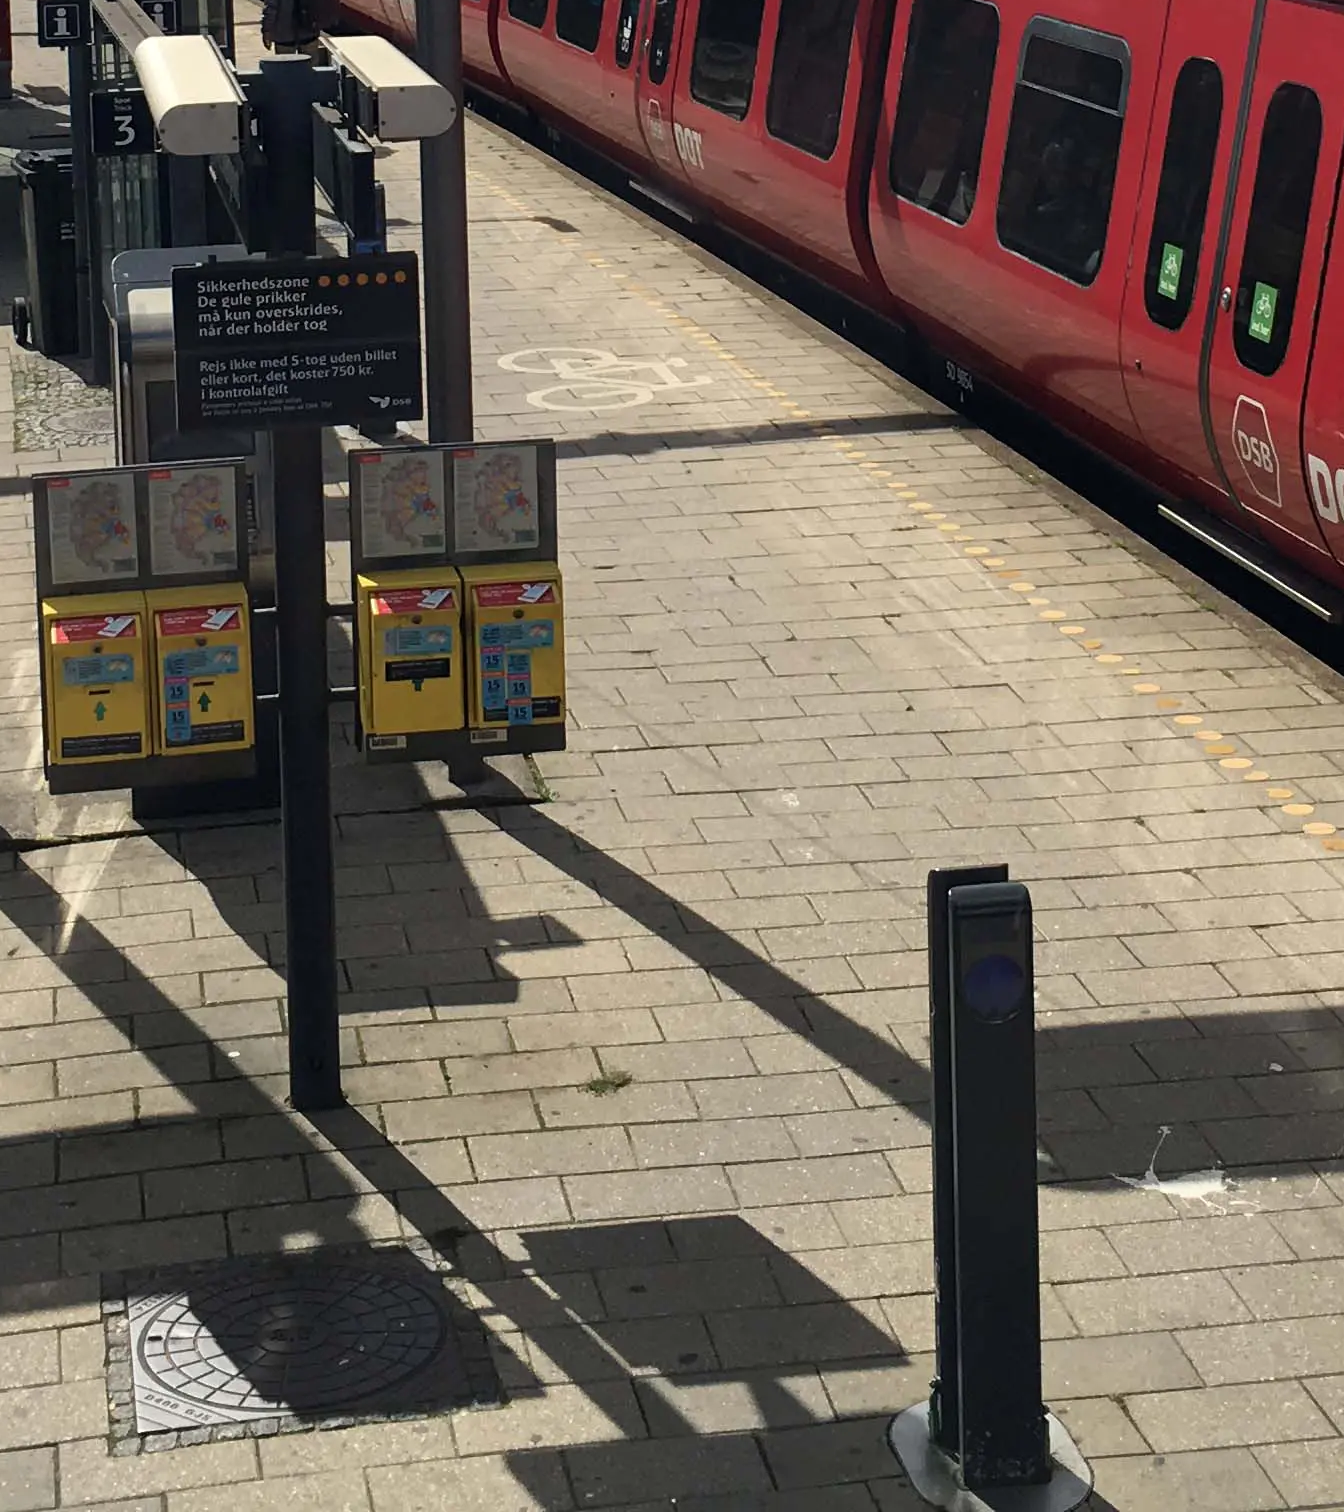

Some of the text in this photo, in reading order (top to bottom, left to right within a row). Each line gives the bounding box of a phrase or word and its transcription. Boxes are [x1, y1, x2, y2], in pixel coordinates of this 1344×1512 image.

[114, 115, 135, 146] 3
[197, 276, 310, 294] Sikkerhedszone
[198, 291, 307, 308] De gule prikker
[199, 303, 343, 323] må kun overskrides,
[199, 319, 328, 337] når der holder tog
[200, 348, 397, 375] Rejs ikke med S-tog uden billet
[200, 363, 374, 387] eller kort, det koster 750 kr.
[209, 383, 289, 400] kontrolafgift
[1237, 429, 1274, 473] DSB
[486, 655, 500, 665] 15
[170, 686, 183, 696] 15
[488, 679, 501, 689] 15
[172, 711, 185, 721] 15
